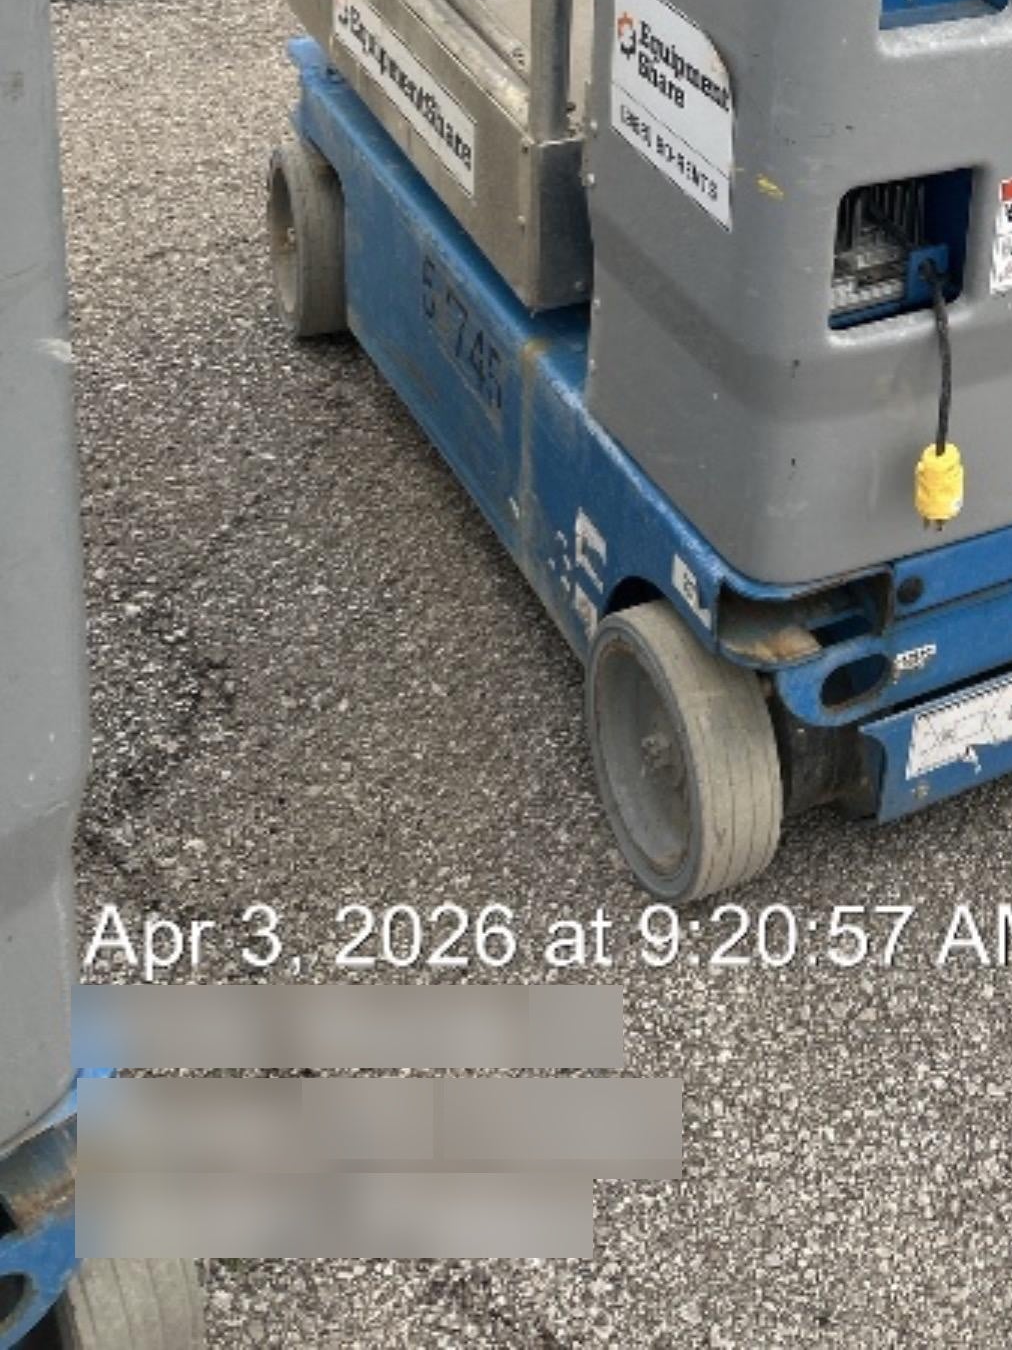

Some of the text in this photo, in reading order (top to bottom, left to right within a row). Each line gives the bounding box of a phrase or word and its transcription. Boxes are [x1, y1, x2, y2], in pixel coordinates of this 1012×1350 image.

[349, 3, 472, 172] EquipmentShare
[638, 51, 686, 110] Share
[639, 19, 731, 113] Equipment
